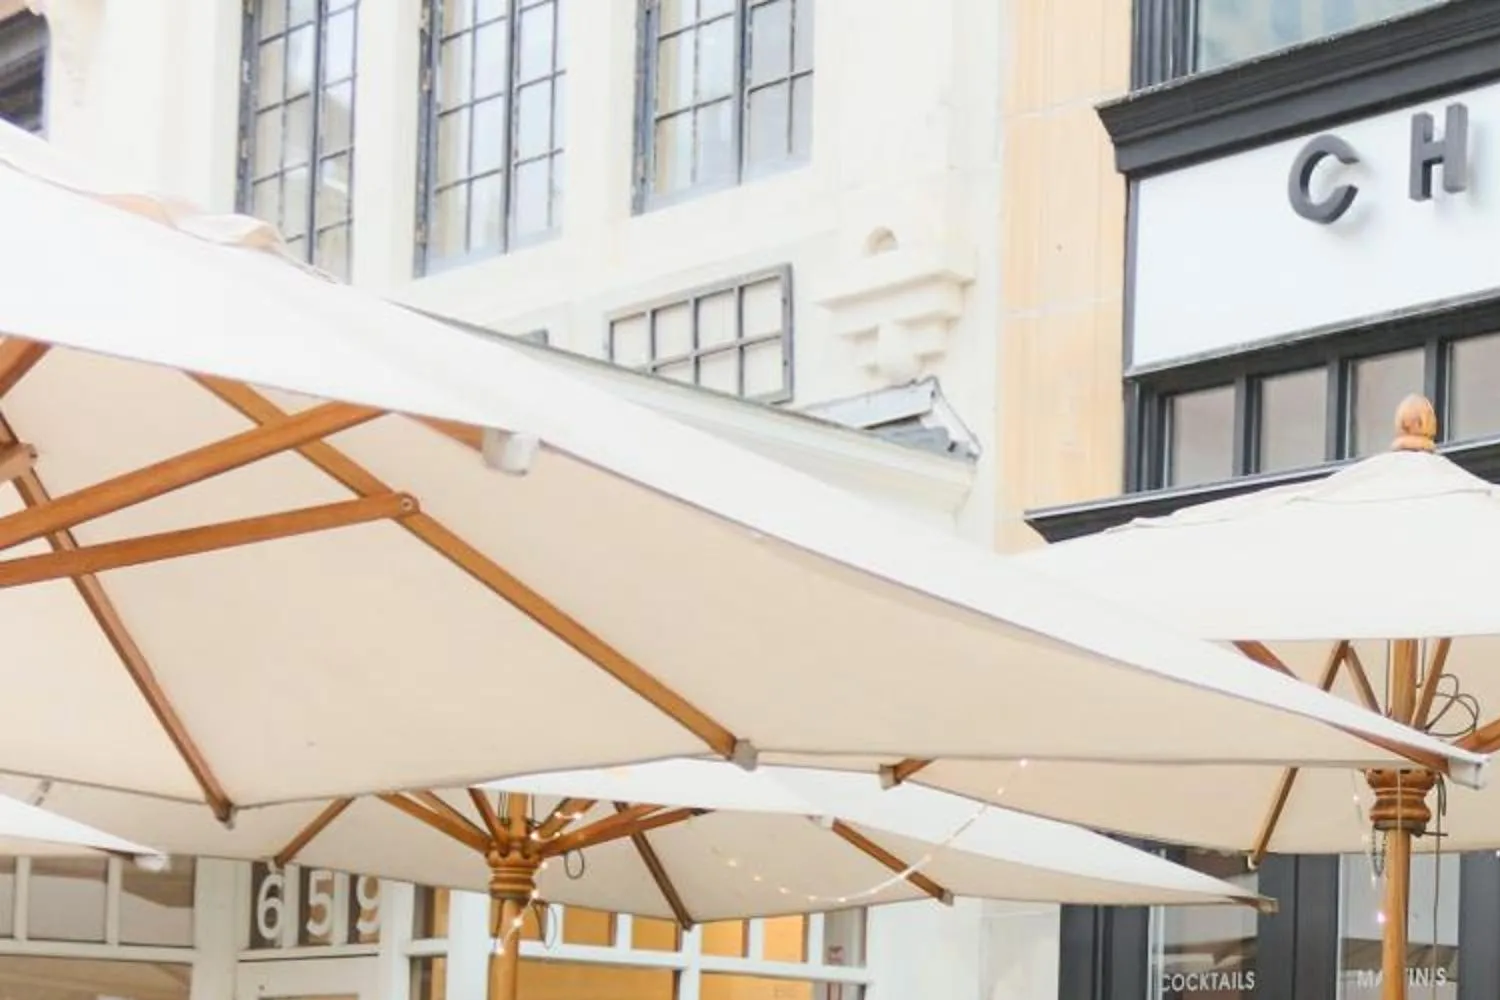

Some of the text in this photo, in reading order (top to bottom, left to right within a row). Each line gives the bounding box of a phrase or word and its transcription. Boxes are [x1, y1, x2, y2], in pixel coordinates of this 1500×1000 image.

[257, 869, 381, 940] 659
[1161, 970, 1256, 993] COCKTAILS
[1357, 966, 1447, 989] MINIS
